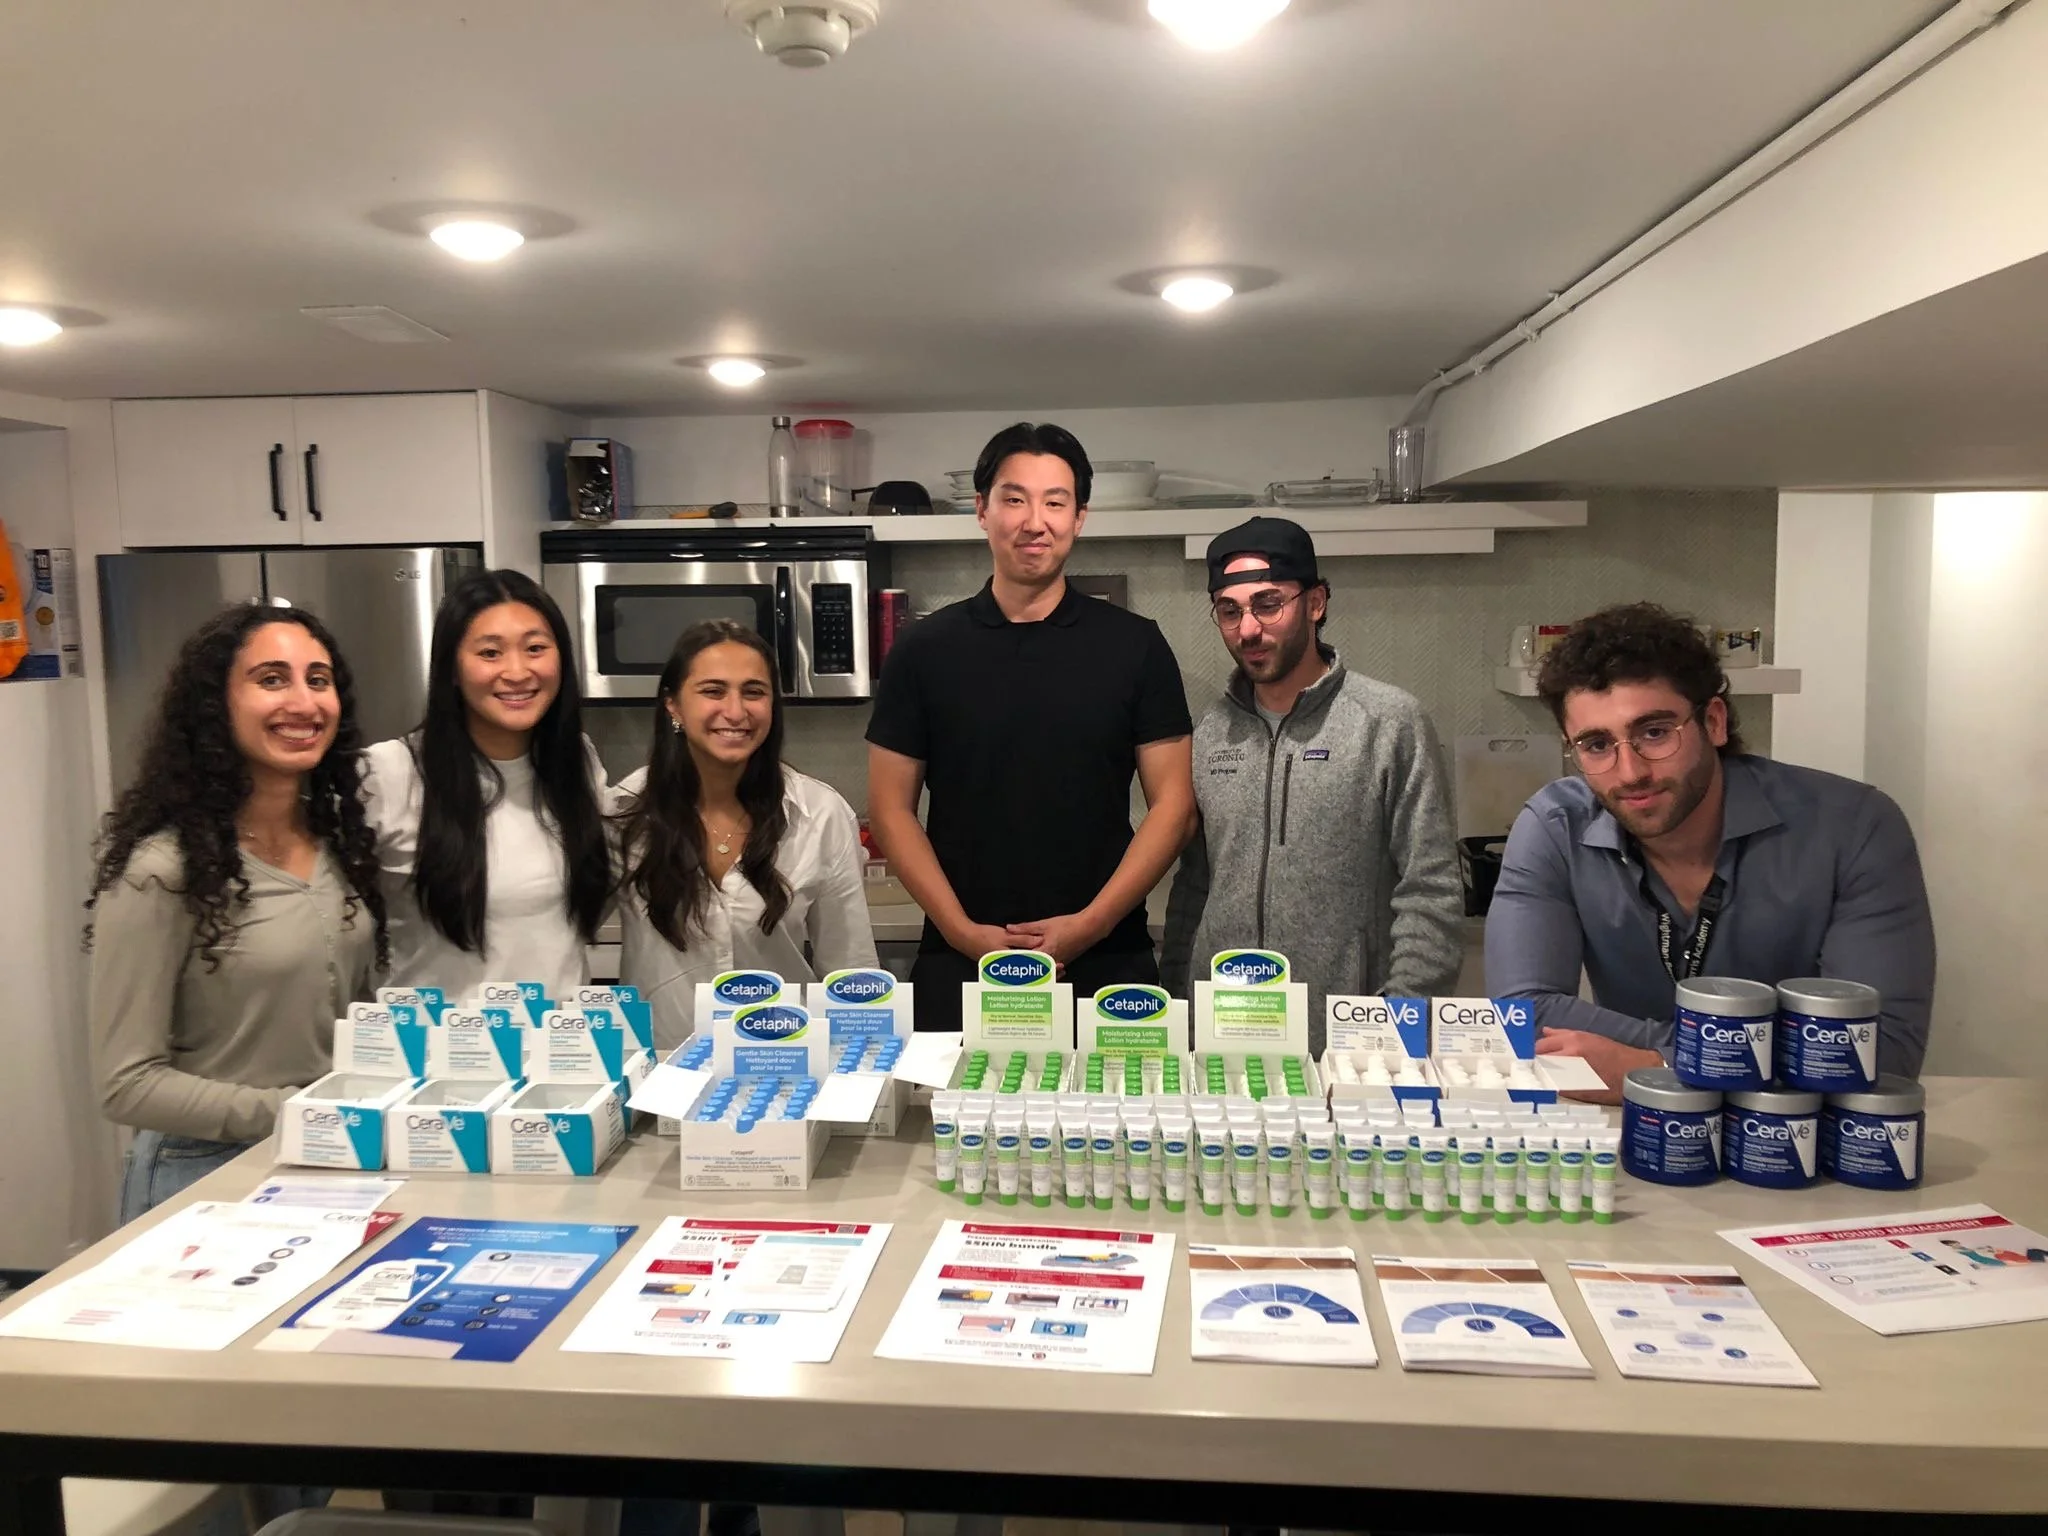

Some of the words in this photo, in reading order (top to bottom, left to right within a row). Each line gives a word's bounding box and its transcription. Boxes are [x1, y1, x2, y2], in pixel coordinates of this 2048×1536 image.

[1692, 917, 1712, 959] Academy
[989, 963, 1044, 979] Cetaphil
[1222, 962, 1278, 977] Cetaphil
[485, 986, 539, 1001] CeraVe
[578, 989, 633, 1004] CeraVe
[721, 983, 774, 997] Cetaphil
[833, 981, 886, 996] Cetaphil
[384, 991, 439, 1005] CeraVe
[1104, 998, 1160, 1013] Cetaphil
[353, 1007, 411, 1025] CeraVe
[447, 1012, 504, 1029] CeraVe
[1333, 1000, 1420, 1025] CeraVe
[1439, 1003, 1527, 1027] CeraVe
[549, 1014, 606, 1030] CeraVe
[742, 1017, 800, 1032] Cetaphil
[1700, 1023, 1766, 1044] CeraVe
[1802, 1024, 1870, 1044] CeraVe
[302, 1108, 362, 1127] CeraVe
[406, 1114, 466, 1131] CeraVe
[510, 1118, 571, 1134] CeraVe
[1743, 1118, 1810, 1140] CeraVe
[1840, 1119, 1909, 1141] CeraVe
[1783, 1234, 1826, 1244] BASIC
[1830, 1229, 1886, 1241] WOUND
[1886, 1219, 1983, 1236] MANAGEMENT
